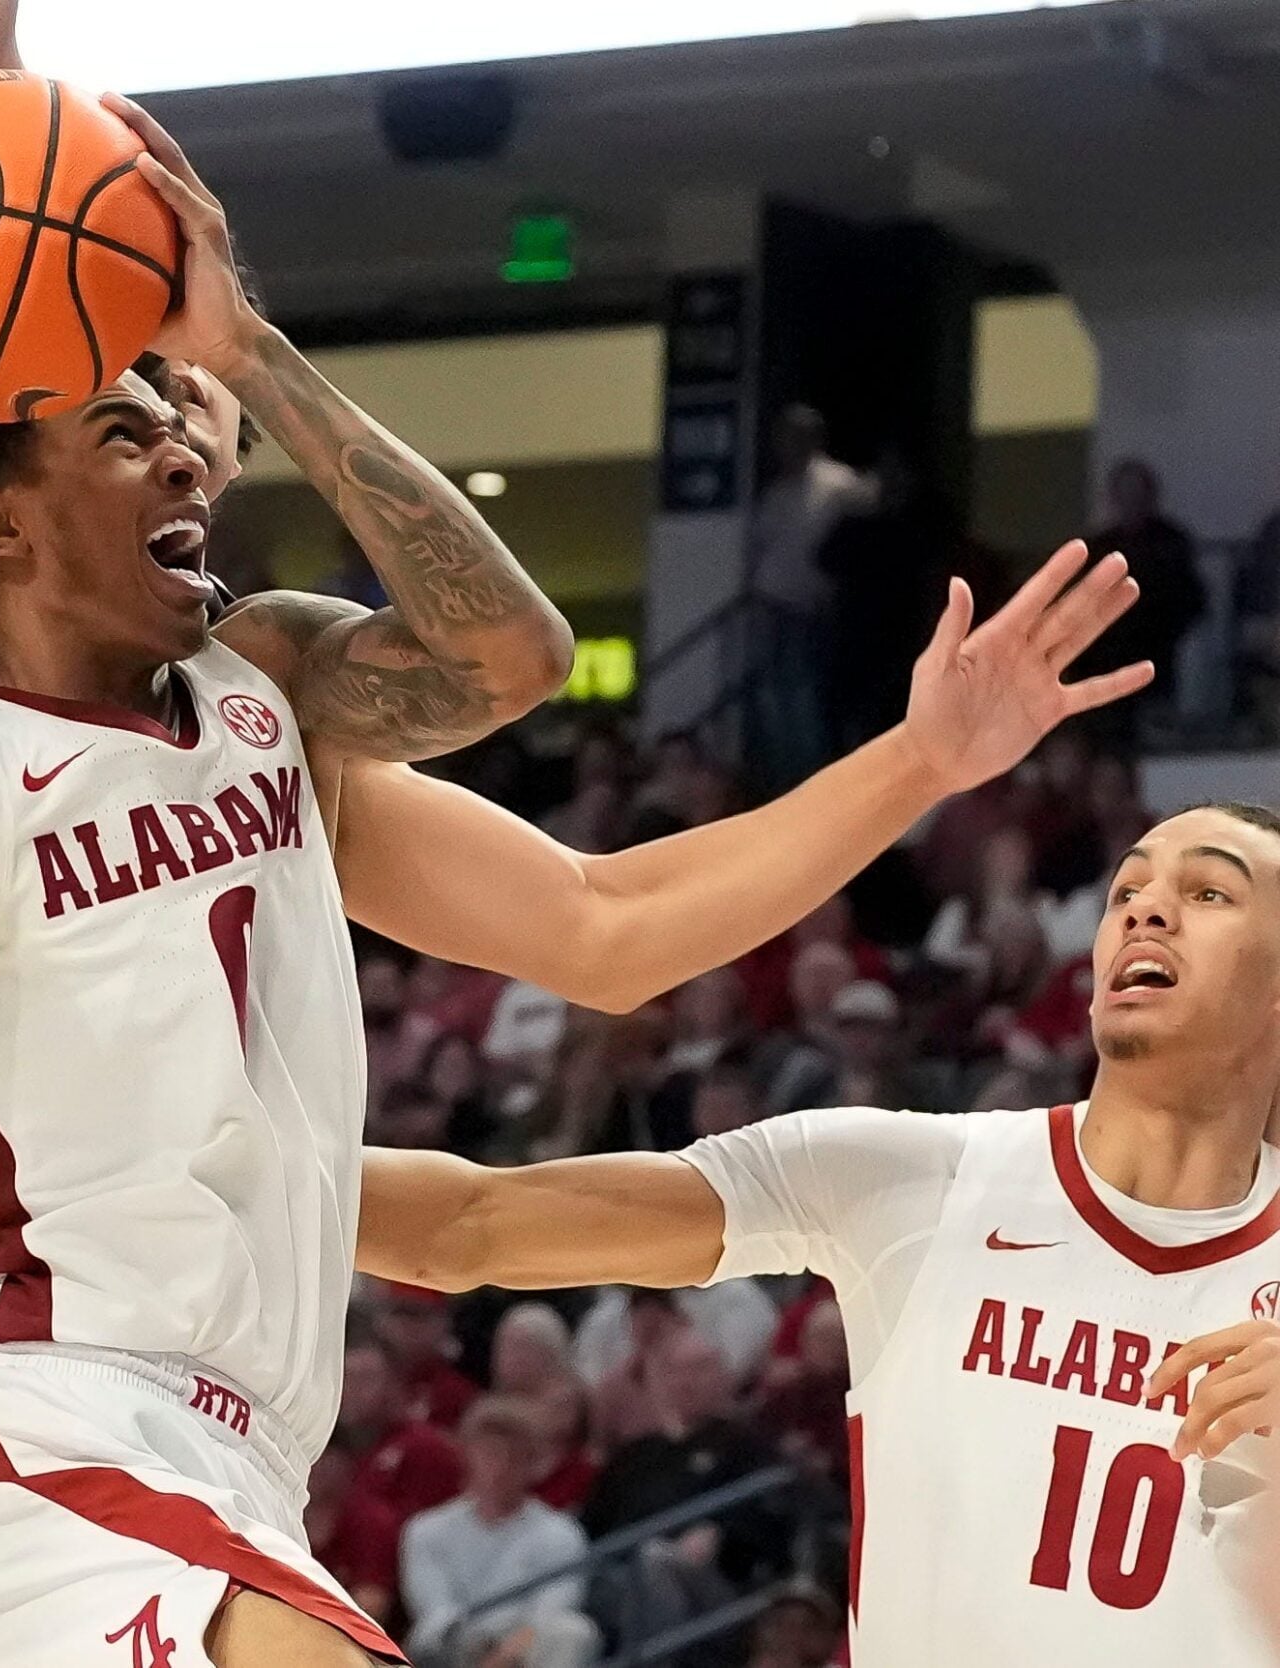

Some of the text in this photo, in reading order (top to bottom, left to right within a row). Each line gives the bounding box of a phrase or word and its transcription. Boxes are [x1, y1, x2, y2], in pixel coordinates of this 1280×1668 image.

[219, 695, 282, 748] SEC
[962, 1298, 1226, 1417] ALABA
[188, 1374, 251, 1437] RTR
[1029, 1424, 1186, 1610] 10
